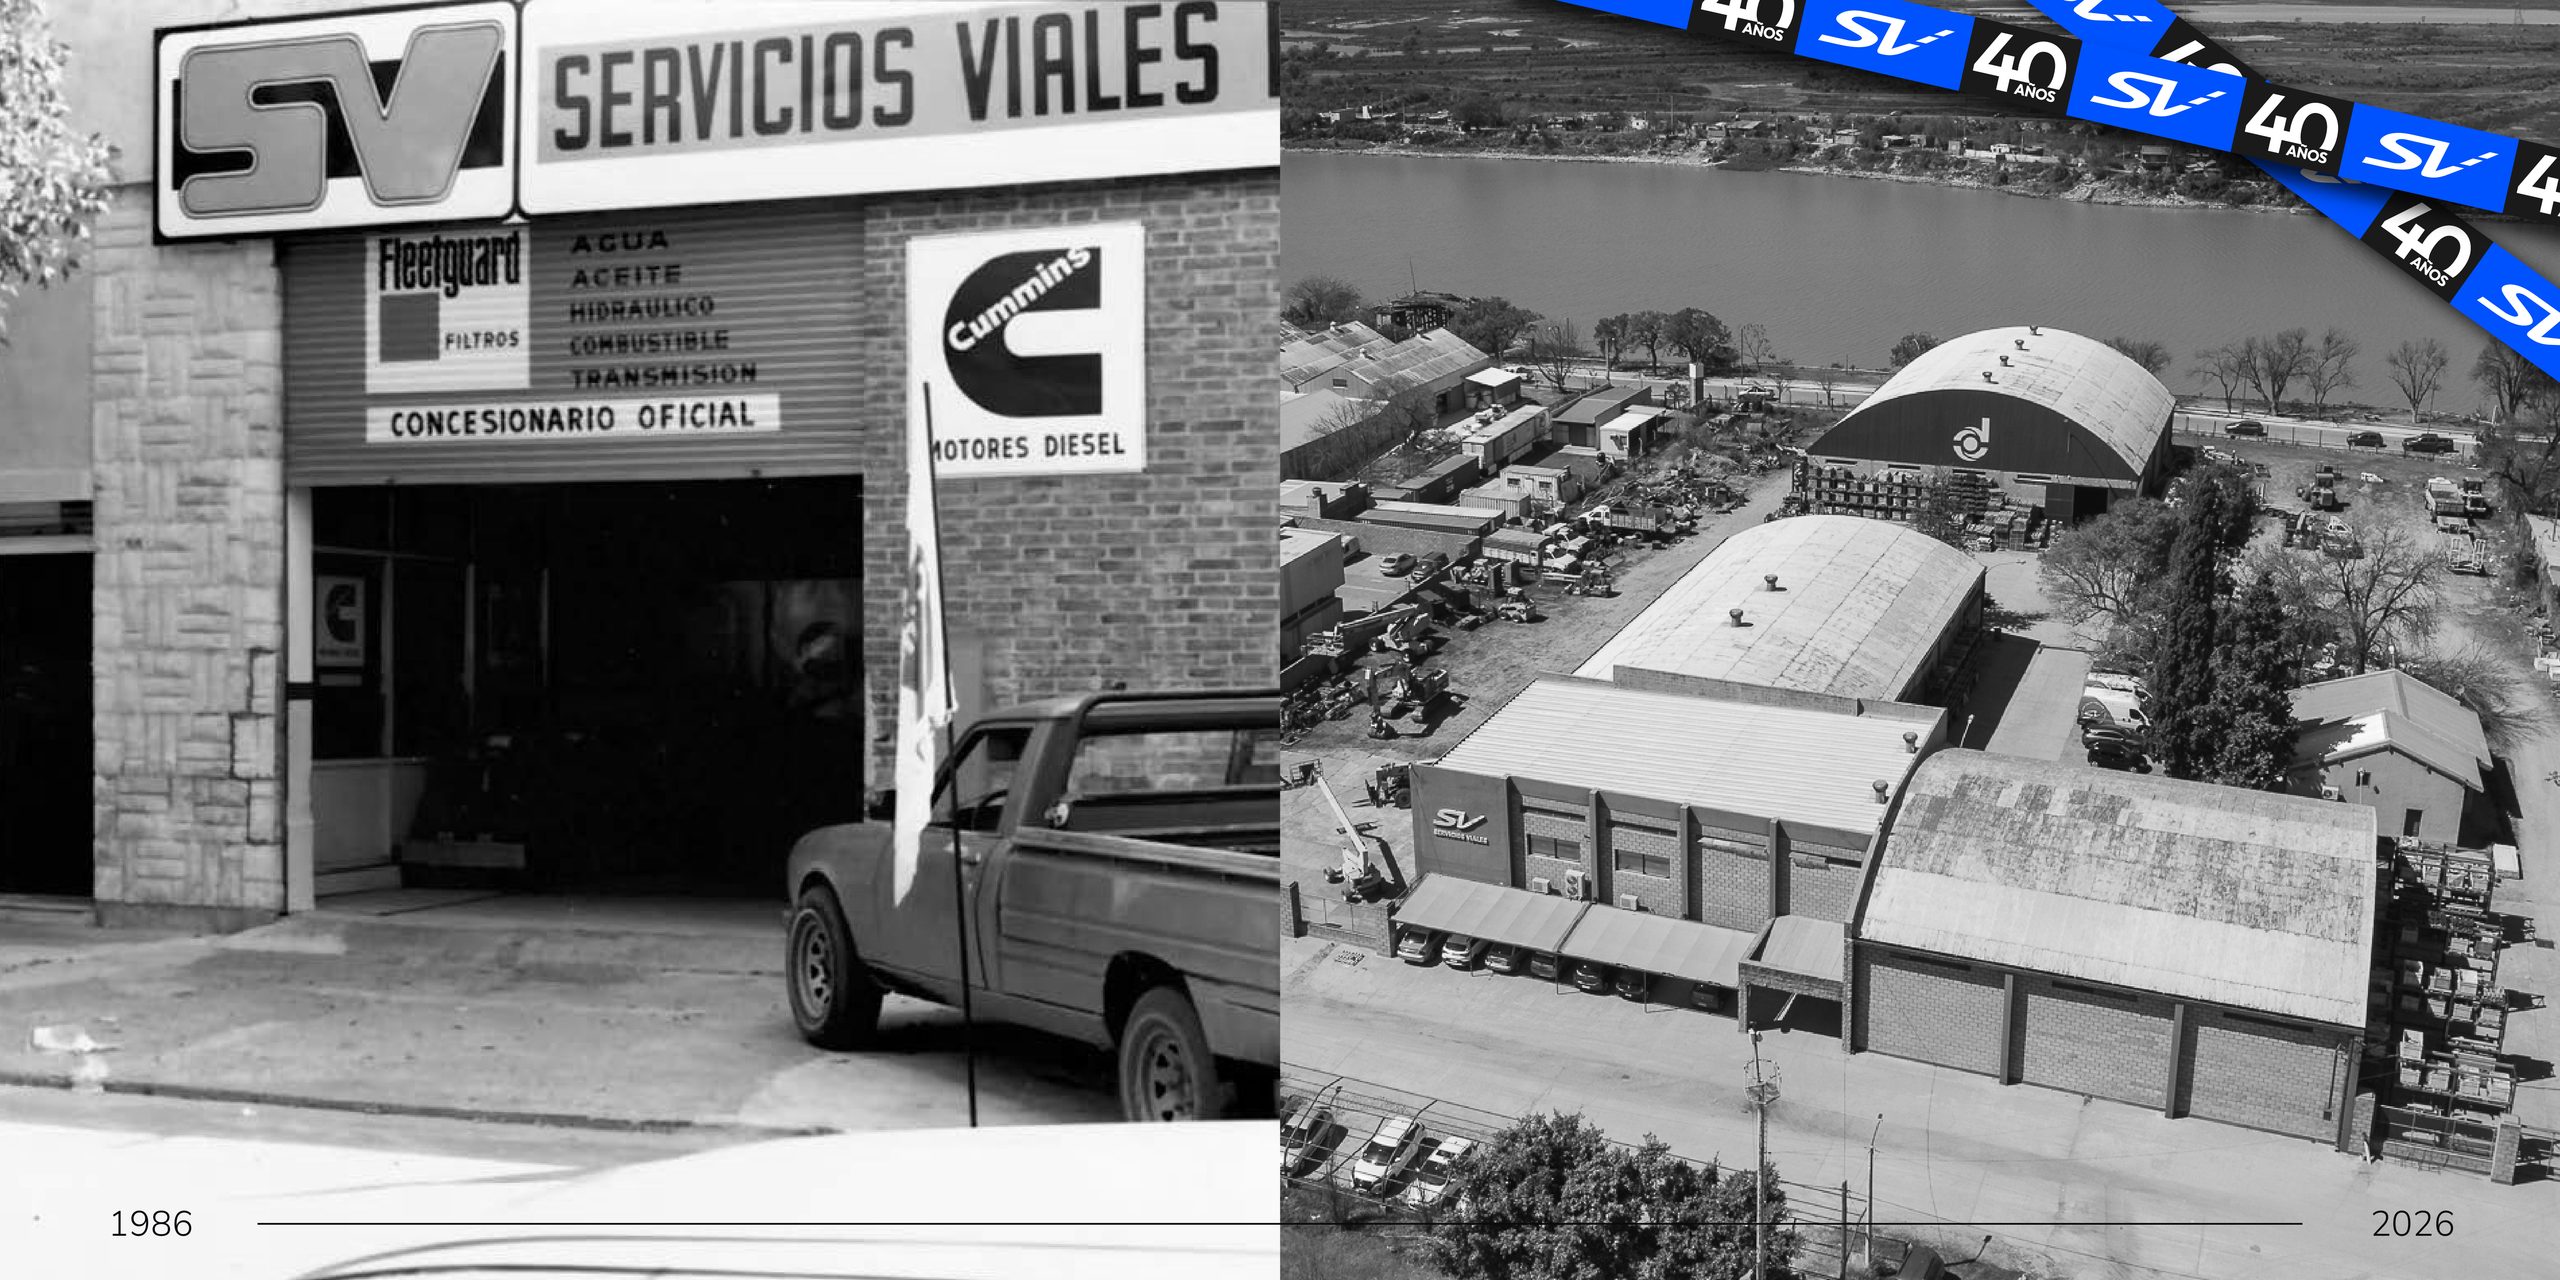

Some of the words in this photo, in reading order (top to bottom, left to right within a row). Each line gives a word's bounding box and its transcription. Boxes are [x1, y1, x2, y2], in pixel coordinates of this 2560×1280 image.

[553, 26, 914, 151] SERVICIOS
[955, 1, 1220, 121] VIALES
[179, 20, 505, 219] SV
[570, 230, 669, 254] AGUA
[379, 230, 520, 298] Fleetguard
[571, 264, 681, 288] ACEITE
[569, 296, 715, 322] HIDRAULICO
[947, 246, 1092, 352] Cummins
[445, 331, 520, 350] FILTROS
[569, 329, 730, 356] COMBUSTIBLE
[570, 361, 757, 391] TRANSMISION
[390, 405, 615, 437] CONCESIONARIO
[638, 400, 754, 430] OFICIAL
[1045, 432, 1126, 457] DIESEL
[1432, 808, 1486, 829] SV
